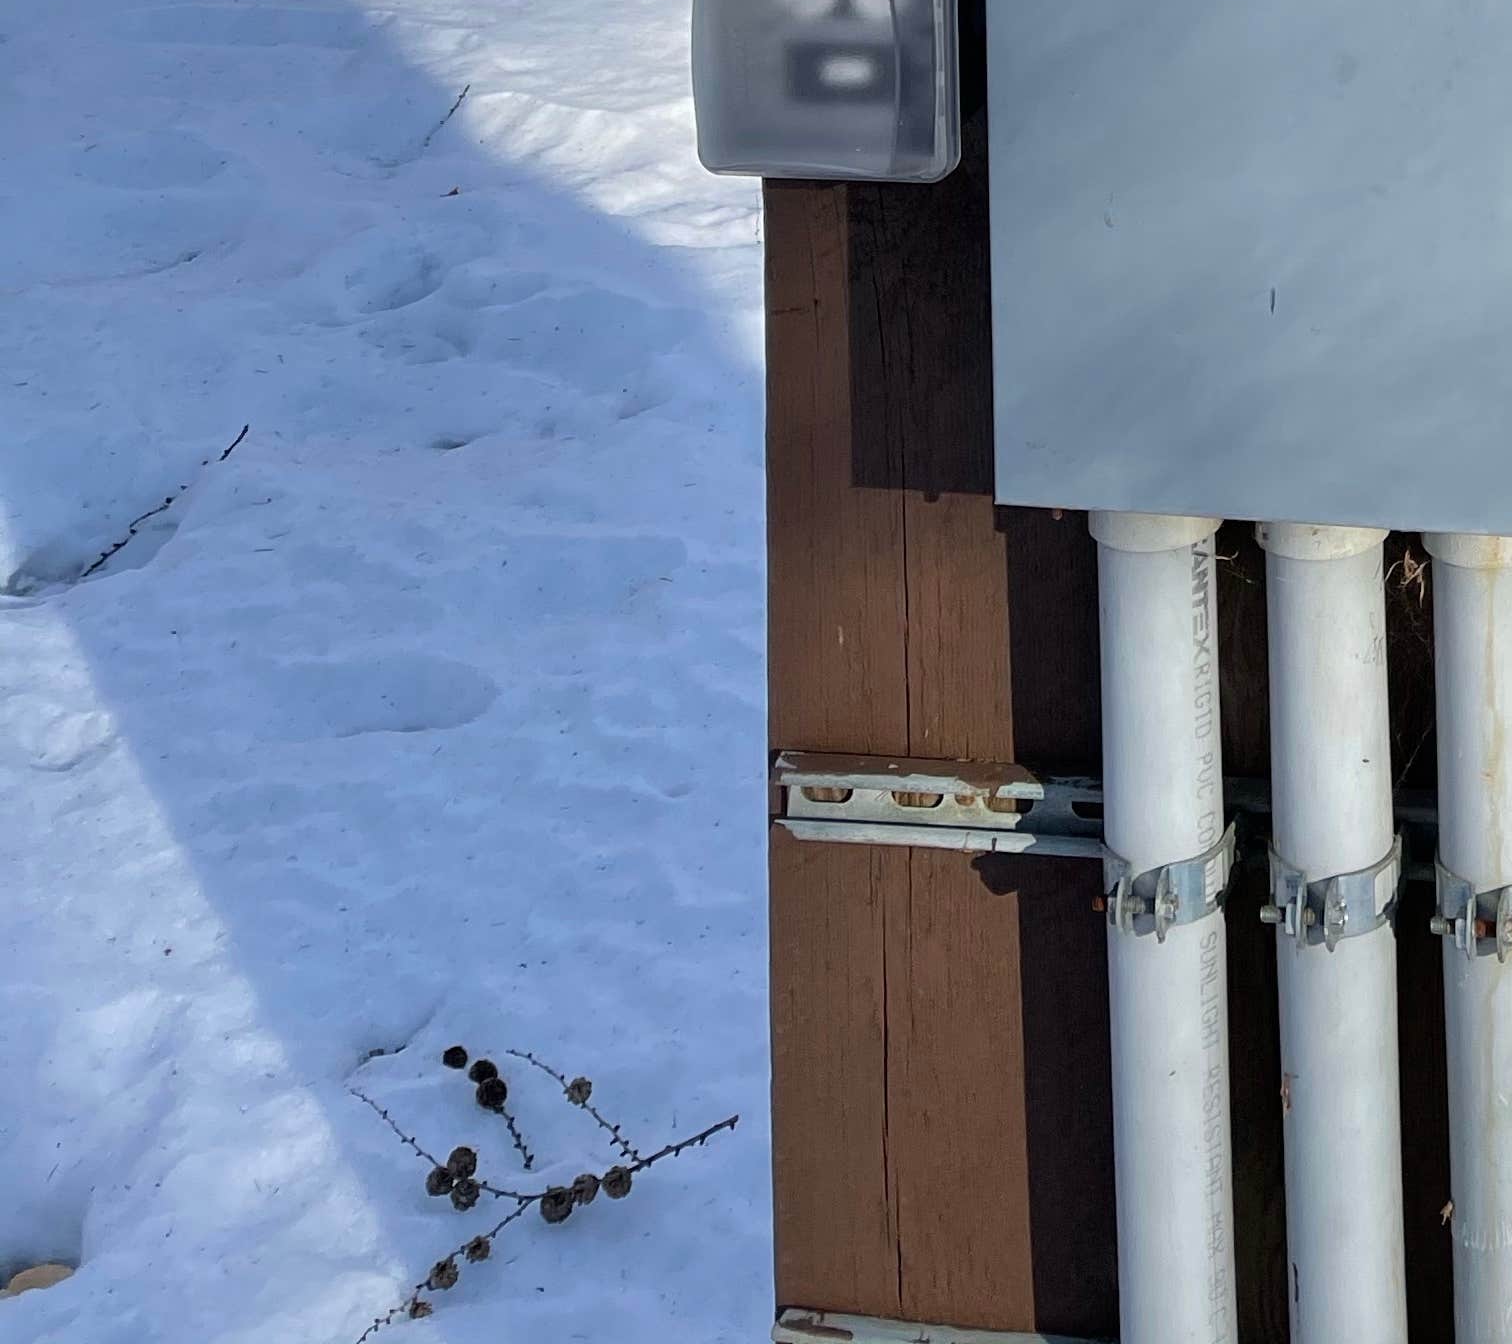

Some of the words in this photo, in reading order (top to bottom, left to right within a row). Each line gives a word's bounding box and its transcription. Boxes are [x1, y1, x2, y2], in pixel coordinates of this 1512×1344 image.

[1194, 662, 1213, 739] RIGID
[1196, 752, 1215, 800] PVC
[1200, 930, 1220, 1050] SUNLIGHT
